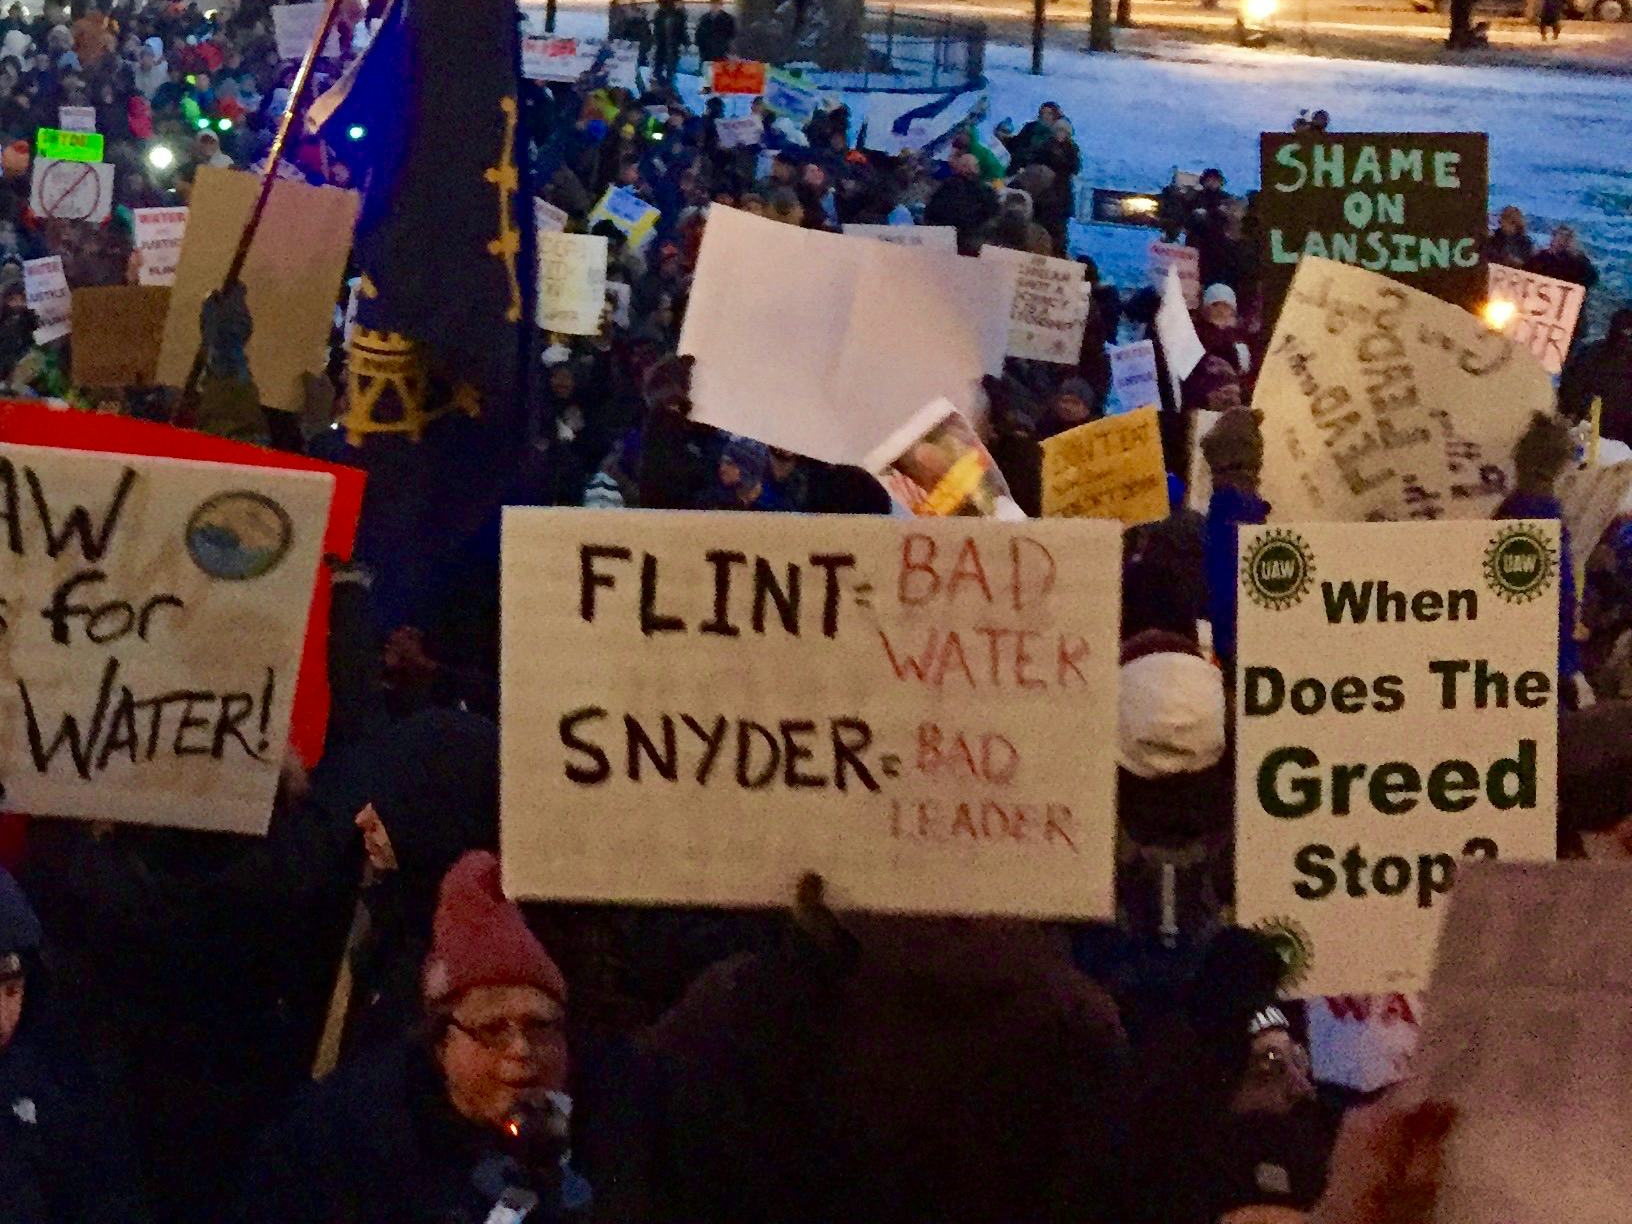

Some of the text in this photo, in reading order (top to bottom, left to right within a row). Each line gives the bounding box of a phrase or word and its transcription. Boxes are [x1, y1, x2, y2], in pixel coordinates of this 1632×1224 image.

[1273, 143, 1462, 193] SHAME
[1343, 191, 1405, 230] ON
[1270, 229, 1480, 272] LANSING
[896, 533, 1058, 611] BAD
[1261, 559, 1296, 580] UAW
[1321, 581, 1478, 624] When
[878, 627, 1090, 689] WATER
[1244, 660, 1552, 716] Does The
[18, 657, 274, 780] WATER!
[915, 721, 1019, 785] BAD
[1257, 739, 1537, 819] Greed
[890, 799, 1077, 848] LEADER
